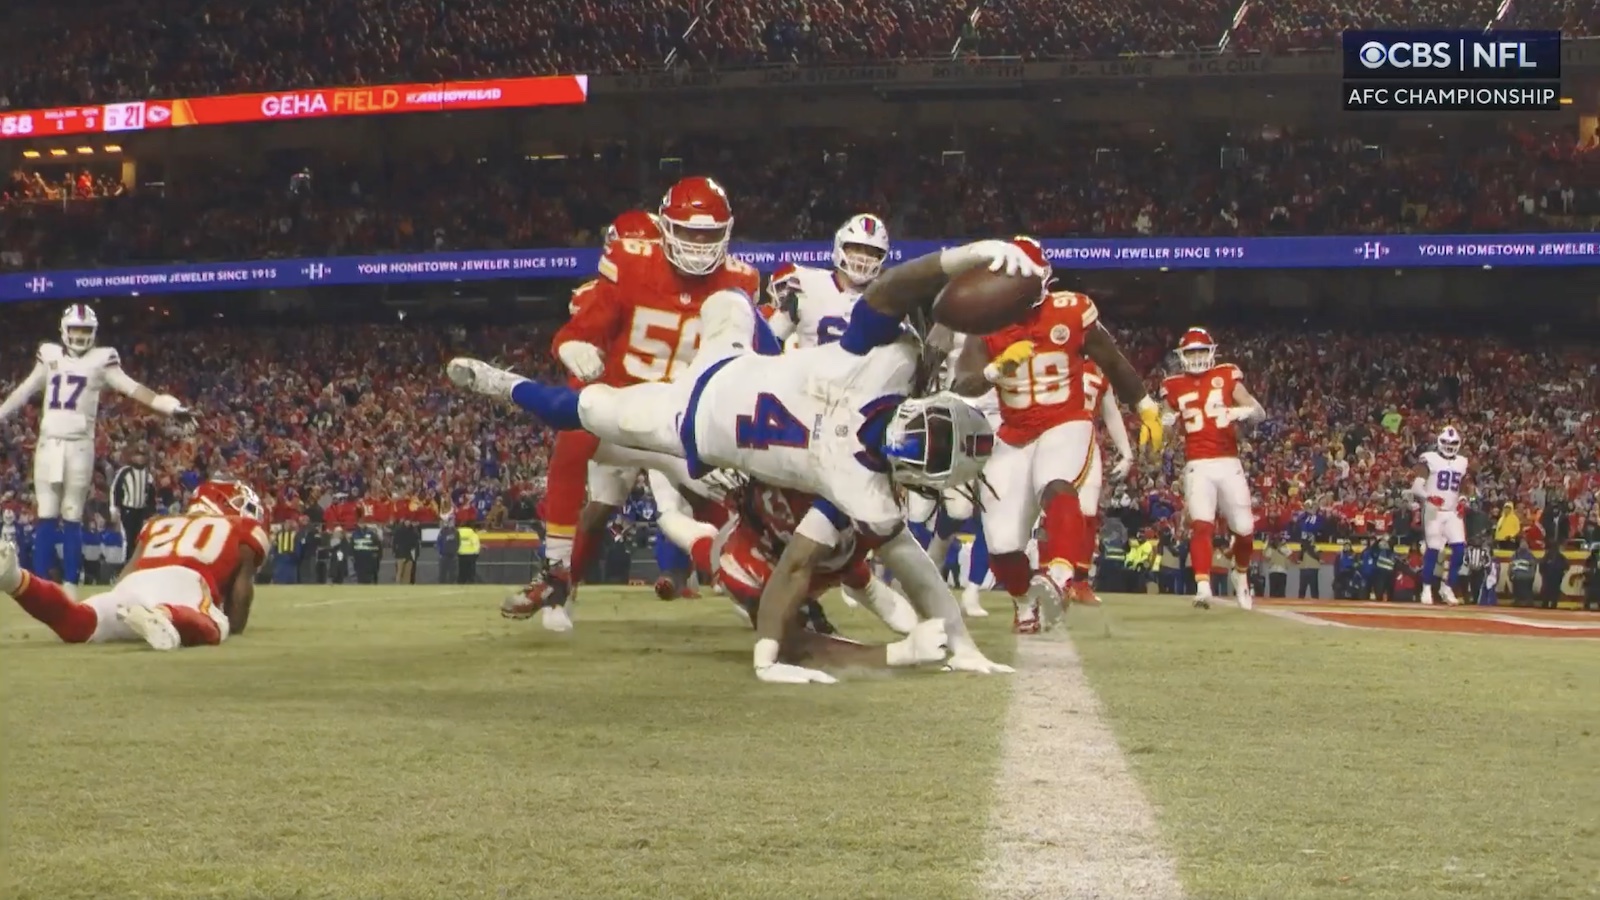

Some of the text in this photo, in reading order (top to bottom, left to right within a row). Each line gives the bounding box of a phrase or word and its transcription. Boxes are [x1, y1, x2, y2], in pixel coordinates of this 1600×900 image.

[261, 93, 328, 117] GEHA
[333, 89, 400, 112] FIELD
[124, 105, 141, 127] 21
[778, 251, 832, 263] JEWELER
[1042, 246, 1244, 260] OMETOWN JEWELER SINCE 1915
[1418, 242, 1595, 256] YOUR HOMETOWN JEWELER
[357, 256, 577, 274] YOUR HOMETOWN JEWELER SINCE 1915
[75, 268, 277, 288] YOUR HOMETOWN JEWELER SINCE 1915
[48, 374, 88, 411] 17
[736, 391, 811, 451] 4
[1177, 387, 1231, 434] 54
[1437, 470, 1462, 492] 85
[142, 516, 233, 566] 20
